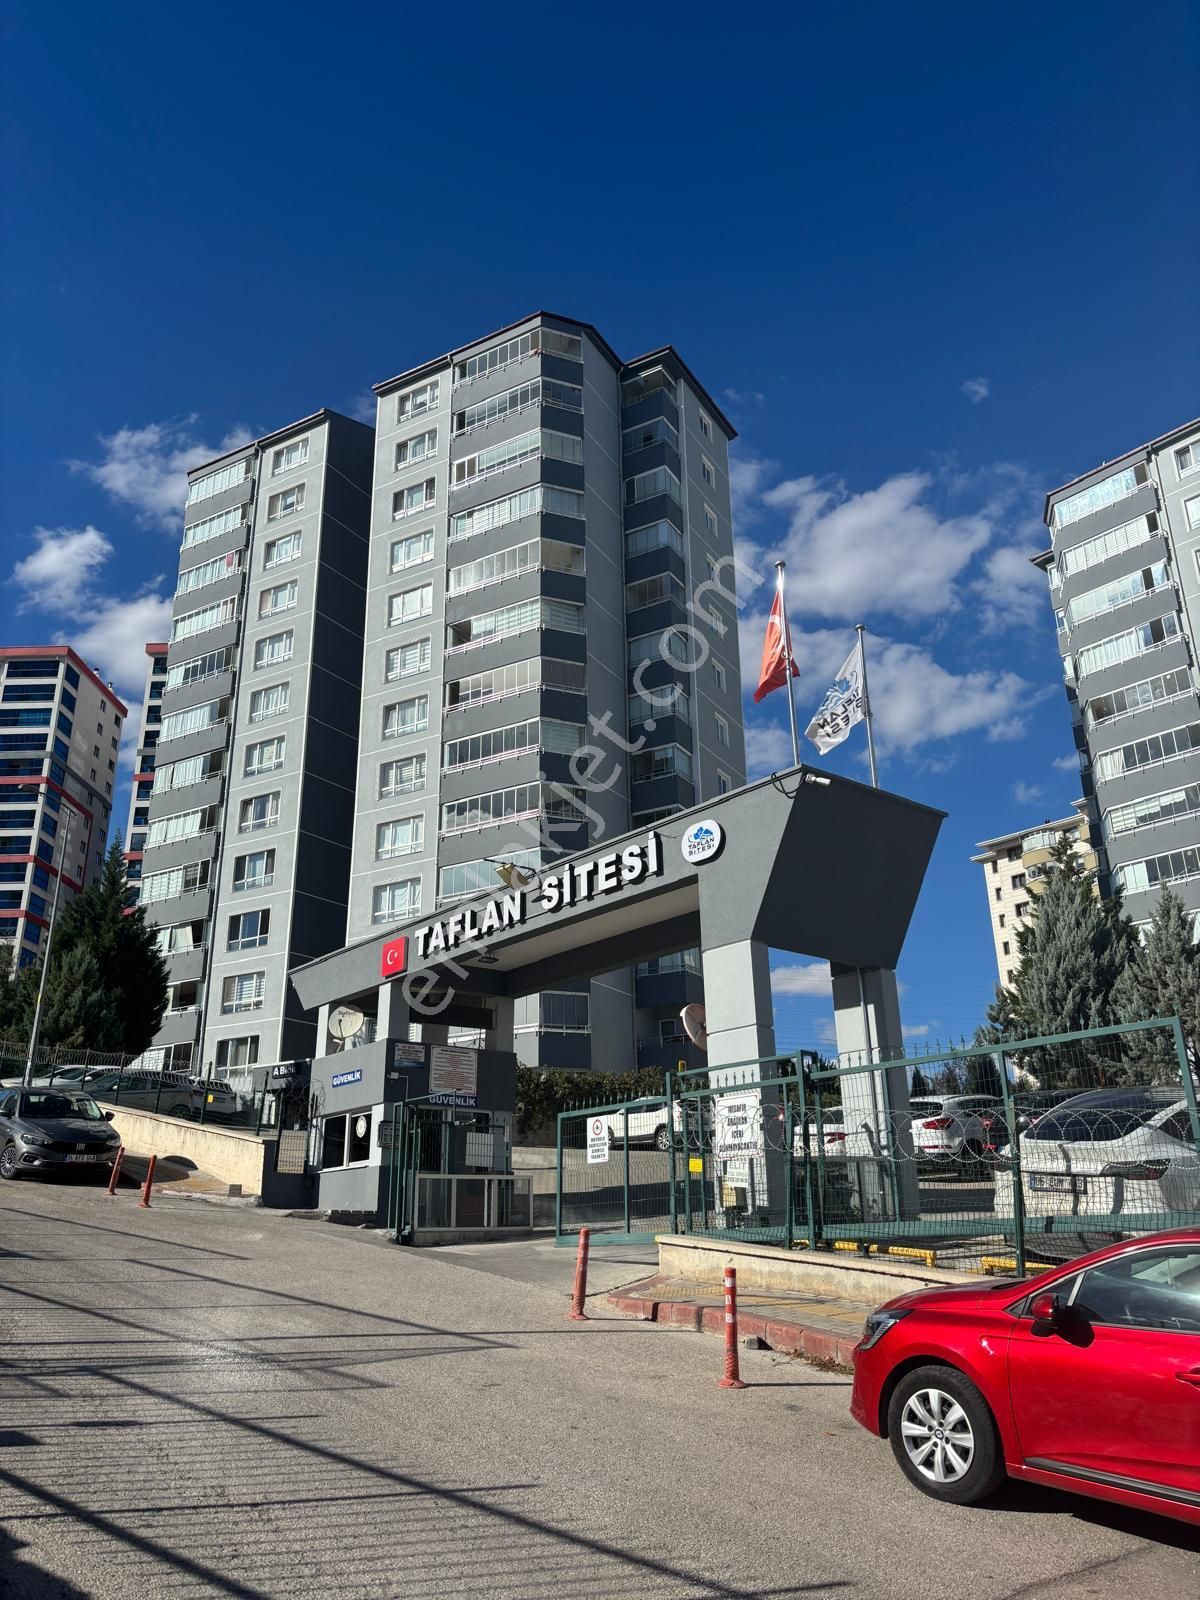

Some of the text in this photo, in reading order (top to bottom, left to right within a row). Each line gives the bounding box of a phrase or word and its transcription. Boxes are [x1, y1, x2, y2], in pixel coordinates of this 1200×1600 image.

[414, 831, 659, 956] TAFLAN SİTESİ
[273, 1067, 279, 1076] A
[333, 1070, 361, 1086] GÜVENLİK
